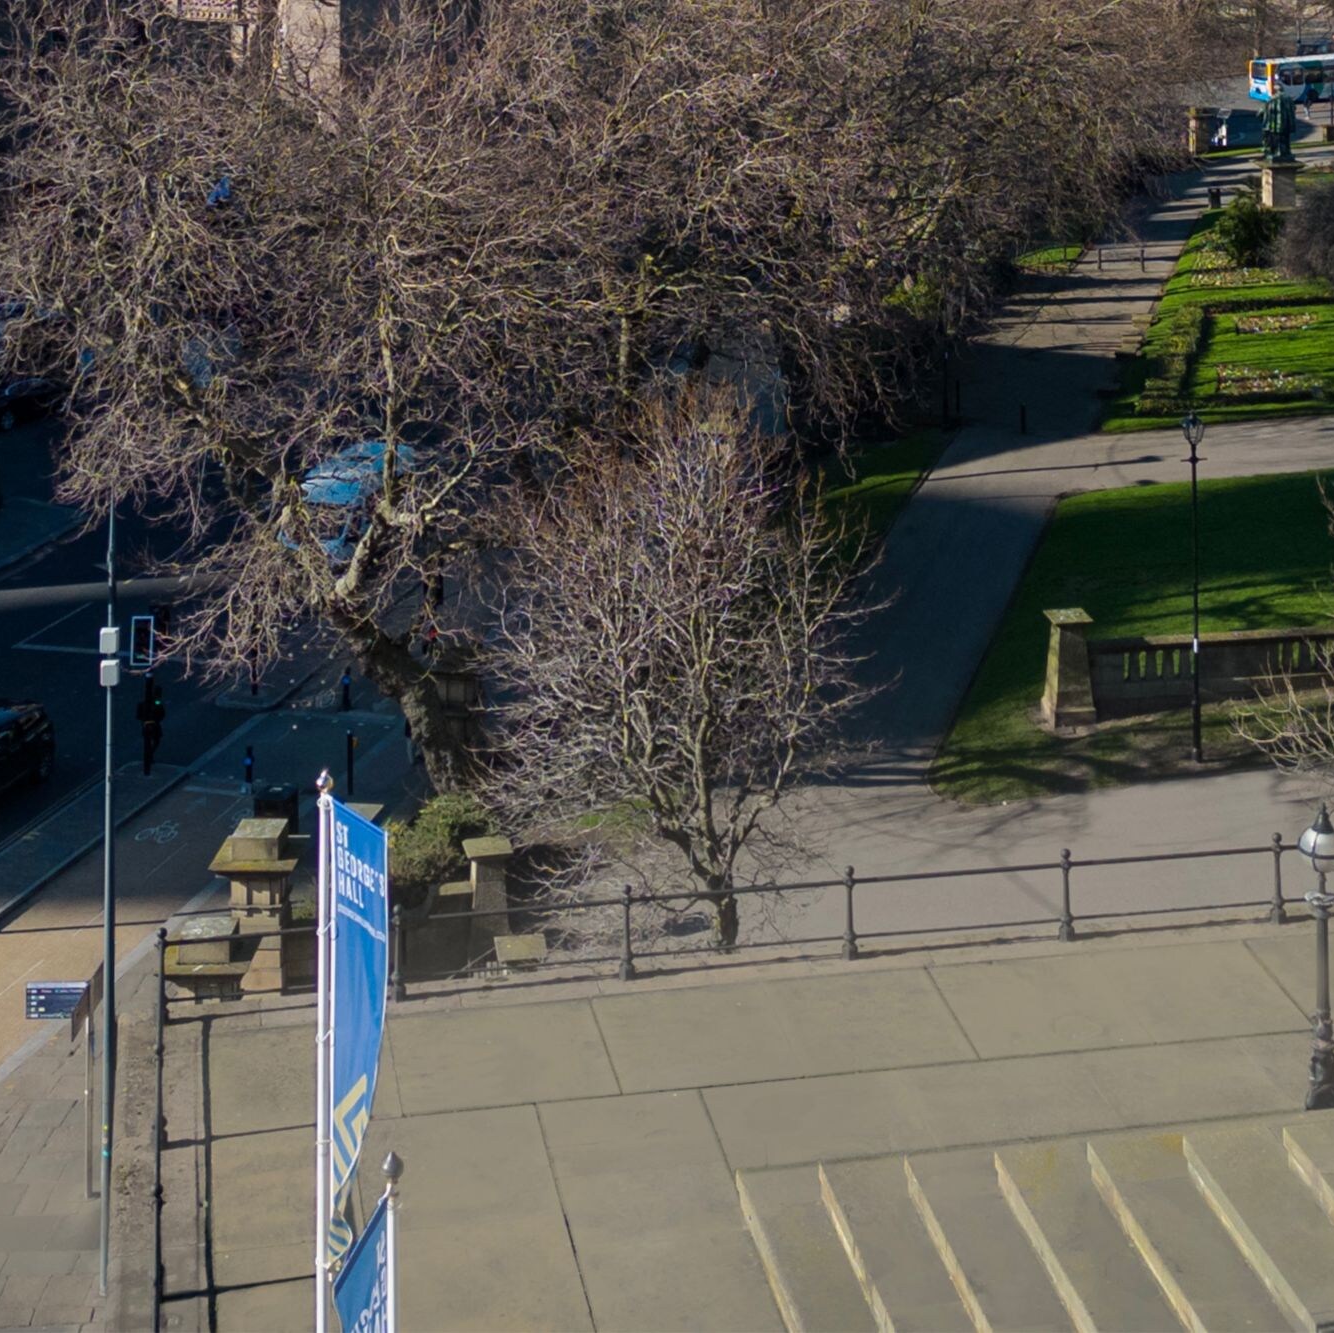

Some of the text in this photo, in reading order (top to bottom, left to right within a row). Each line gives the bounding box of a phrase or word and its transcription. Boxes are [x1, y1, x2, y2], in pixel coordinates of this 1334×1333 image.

[336, 821, 348, 848] ST
[337, 845, 385, 897] GEORGE'S
[338, 870, 364, 909] HALL
